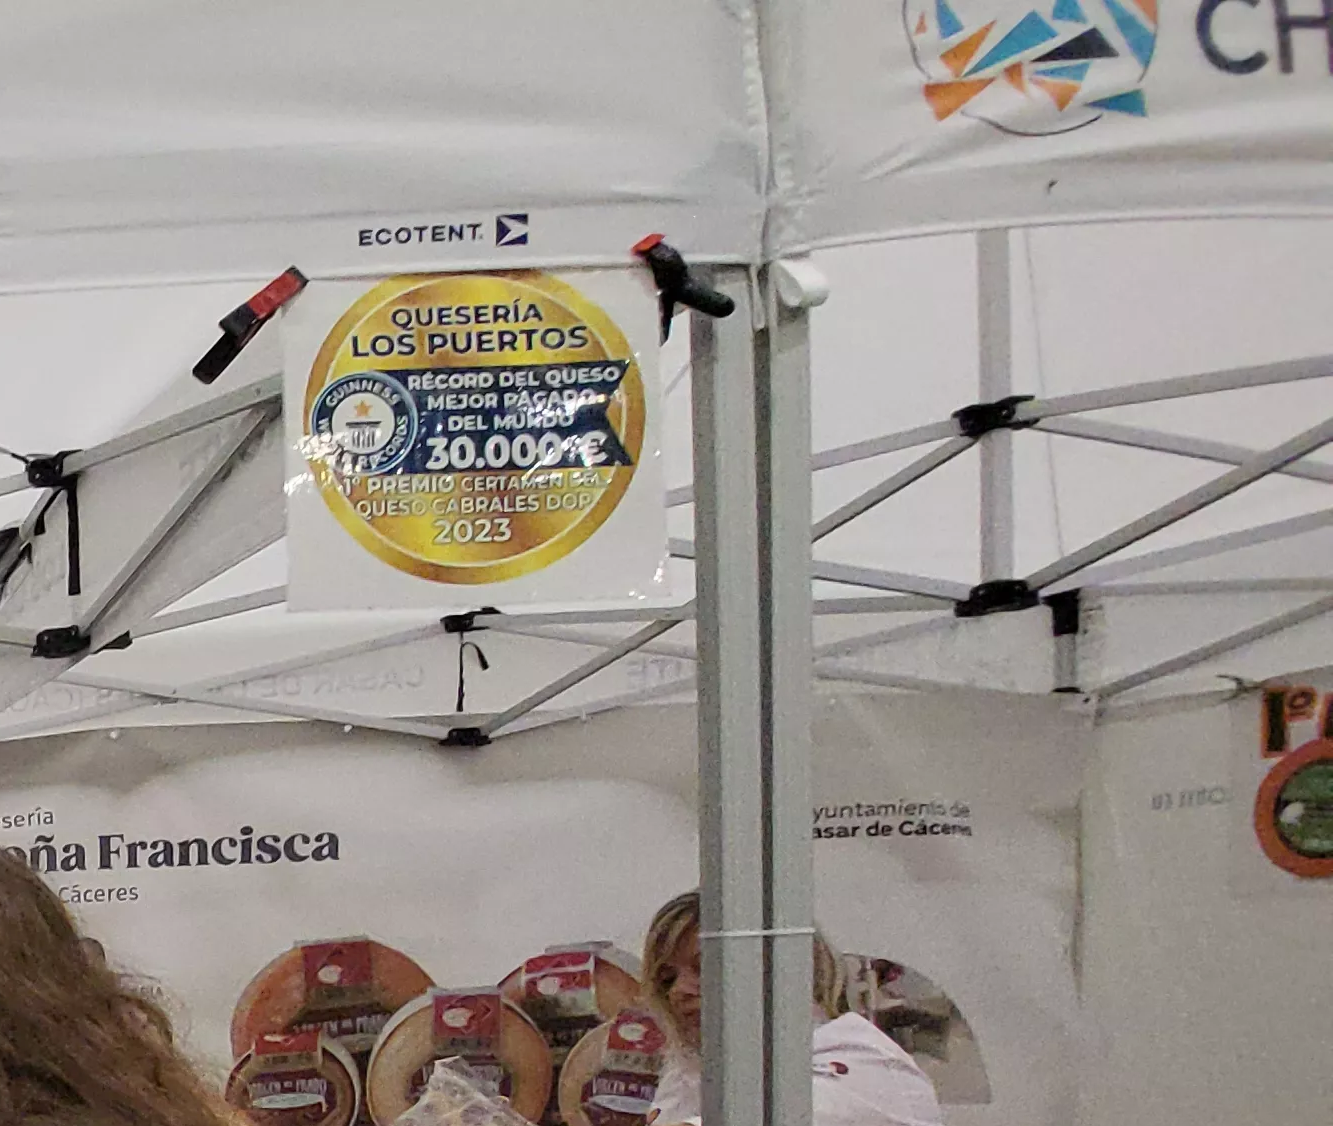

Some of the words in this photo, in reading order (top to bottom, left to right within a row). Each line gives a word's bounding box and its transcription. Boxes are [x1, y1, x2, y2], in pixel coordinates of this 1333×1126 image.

[358, 223, 483, 246] ECOTENT
[391, 299, 543, 330] QUESERÍA
[352, 334, 416, 358] LOS
[428, 326, 589, 355] PUERTOS
[407, 372, 494, 392] RÉCORD
[499, 370, 540, 388] DEL
[544, 367, 621, 388] QUESO
[326, 380, 402, 408] GUINNESS
[428, 392, 498, 411] MEJOR
[448, 414, 488, 431] DEL
[425, 432, 562, 471] 30.000
[367, 475, 455, 495] PREMIO
[356, 500, 427, 521] QUESO
[433, 493, 540, 515] CABRALES
[546, 491, 592, 511] DOP
[433, 518, 512, 544] 2023
[812, 823, 860, 839] asar
[865, 821, 893, 837] de
[97, 825, 341, 870] Francisca
[57, 884, 140, 903] Cáceres
